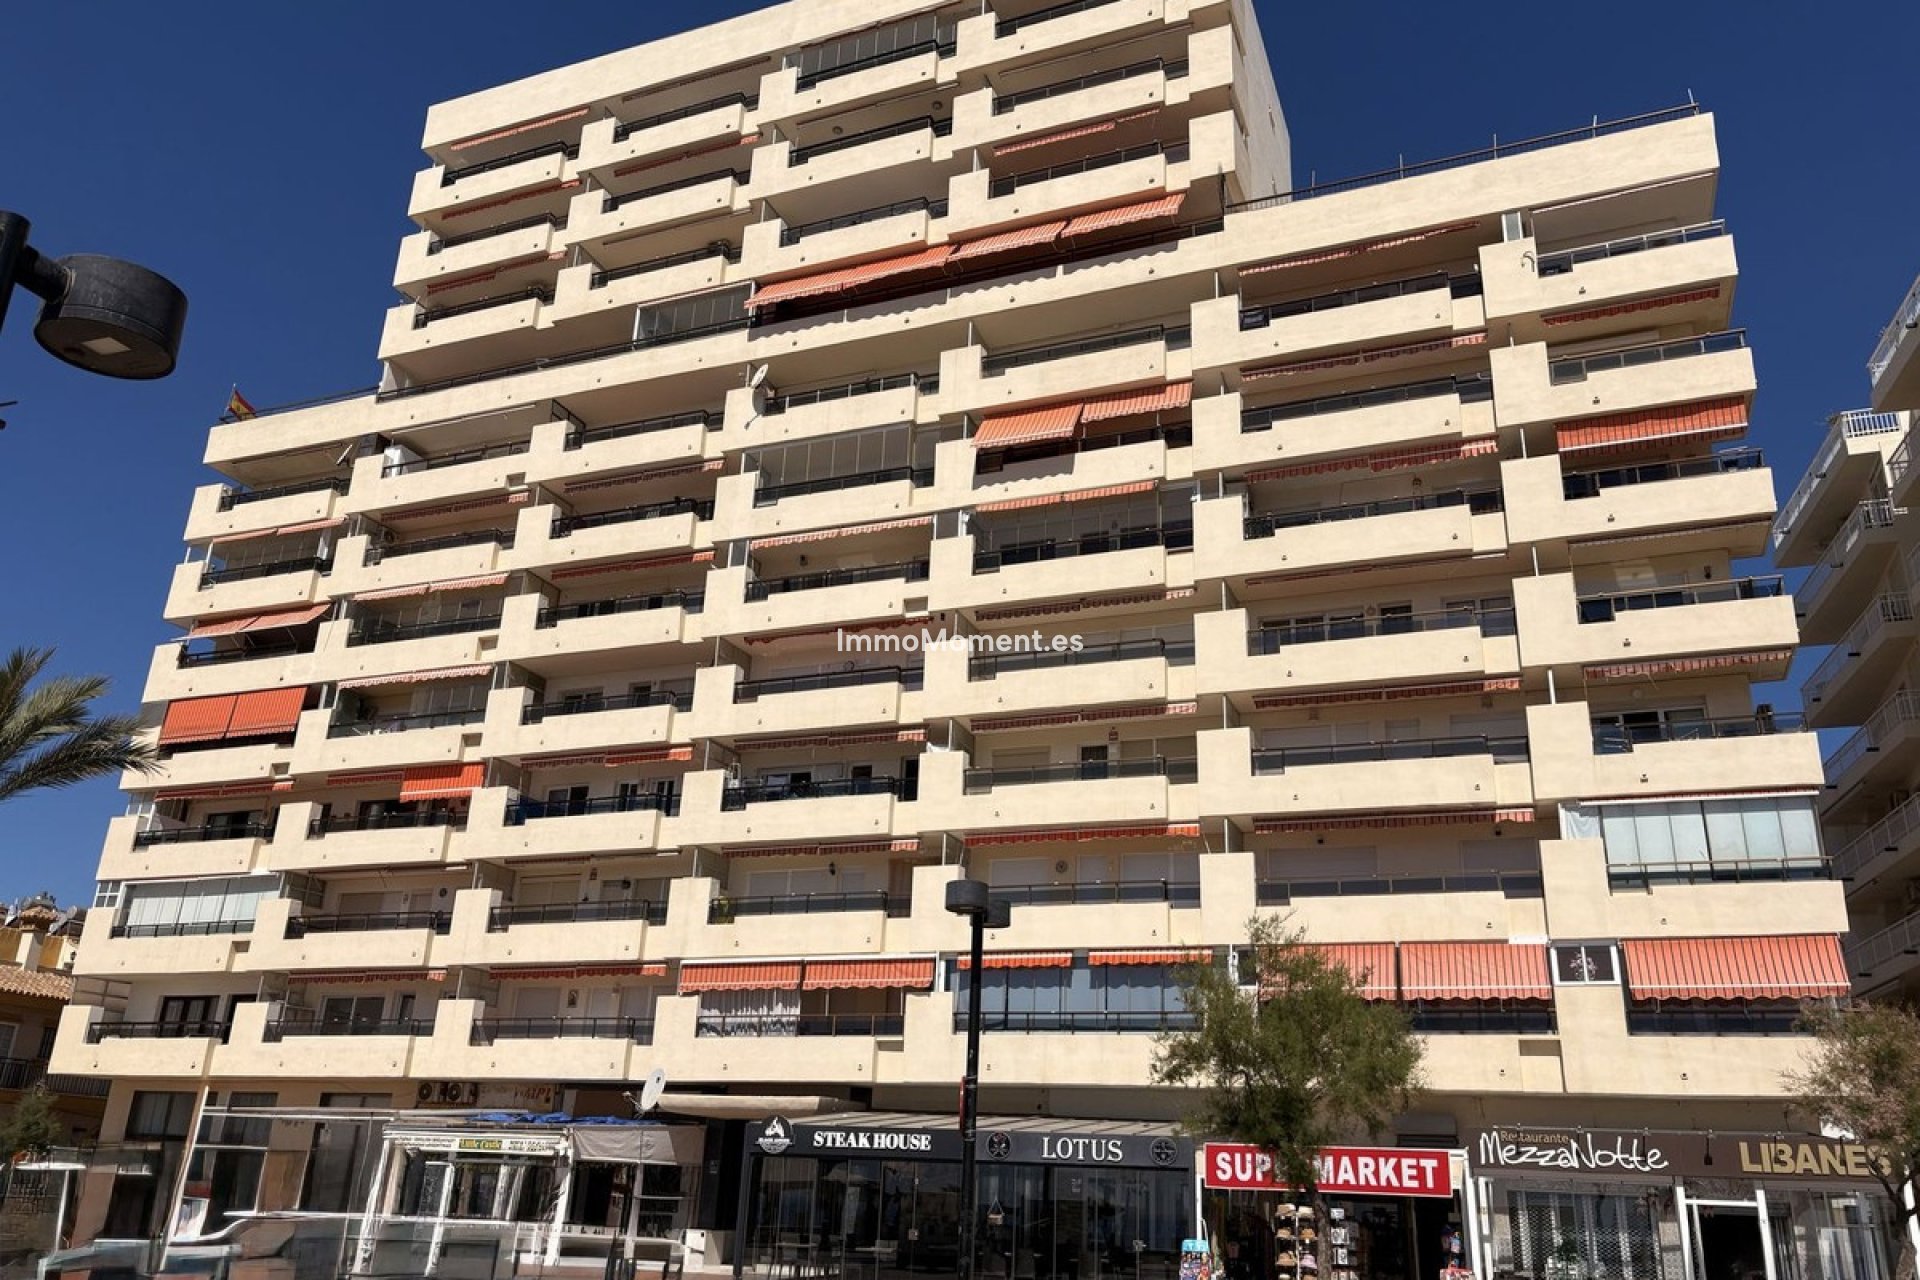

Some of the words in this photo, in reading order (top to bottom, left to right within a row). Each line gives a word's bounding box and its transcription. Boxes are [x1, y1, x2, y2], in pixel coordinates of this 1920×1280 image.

[812, 1130, 871, 1148] STEAK
[873, 1133, 932, 1151] HOUSE
[1041, 1136, 1123, 1162] LOTUS
[1215, 1151, 1438, 1189] SUPMARKET
